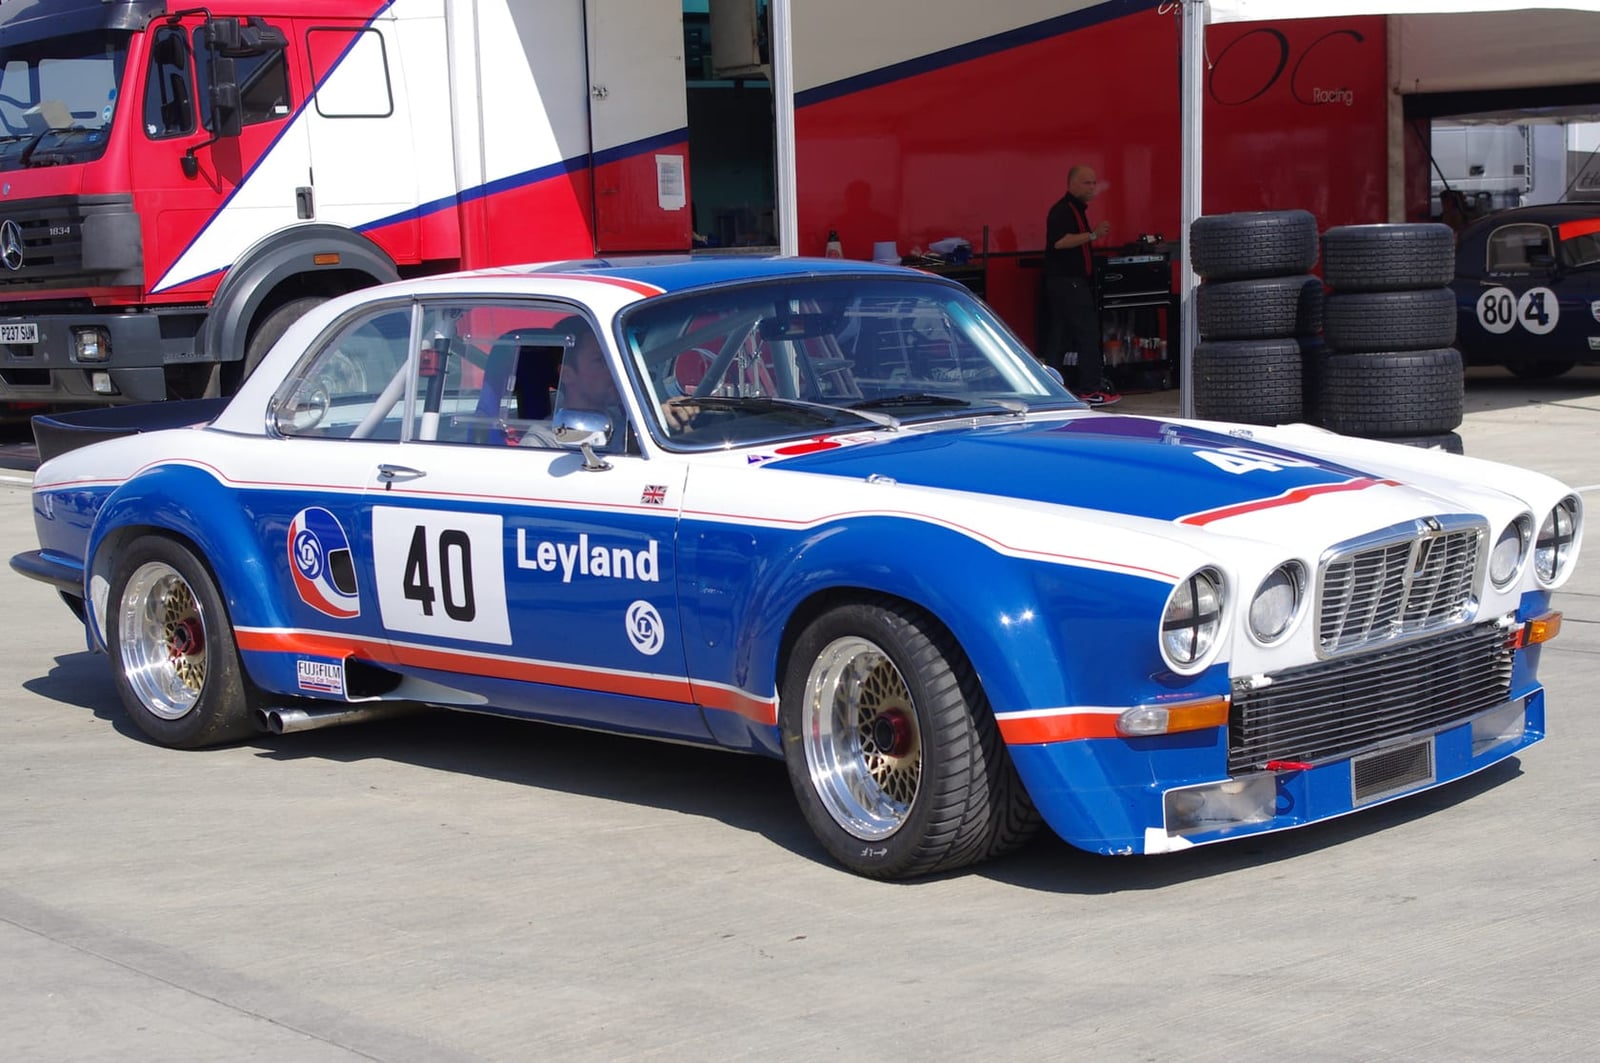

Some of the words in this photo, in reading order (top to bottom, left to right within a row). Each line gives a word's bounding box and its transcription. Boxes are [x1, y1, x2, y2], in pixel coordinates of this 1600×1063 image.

[1313, 87, 1353, 106] Racing
[49, 226, 70, 236] 1834
[1483, 294, 1512, 325] 80
[1524, 292, 1549, 327] 4
[1192, 447, 1320, 474] 40
[517, 528, 659, 583] Leyland
[403, 525, 475, 622] 40
[298, 662, 341, 678] FUJIFILM
